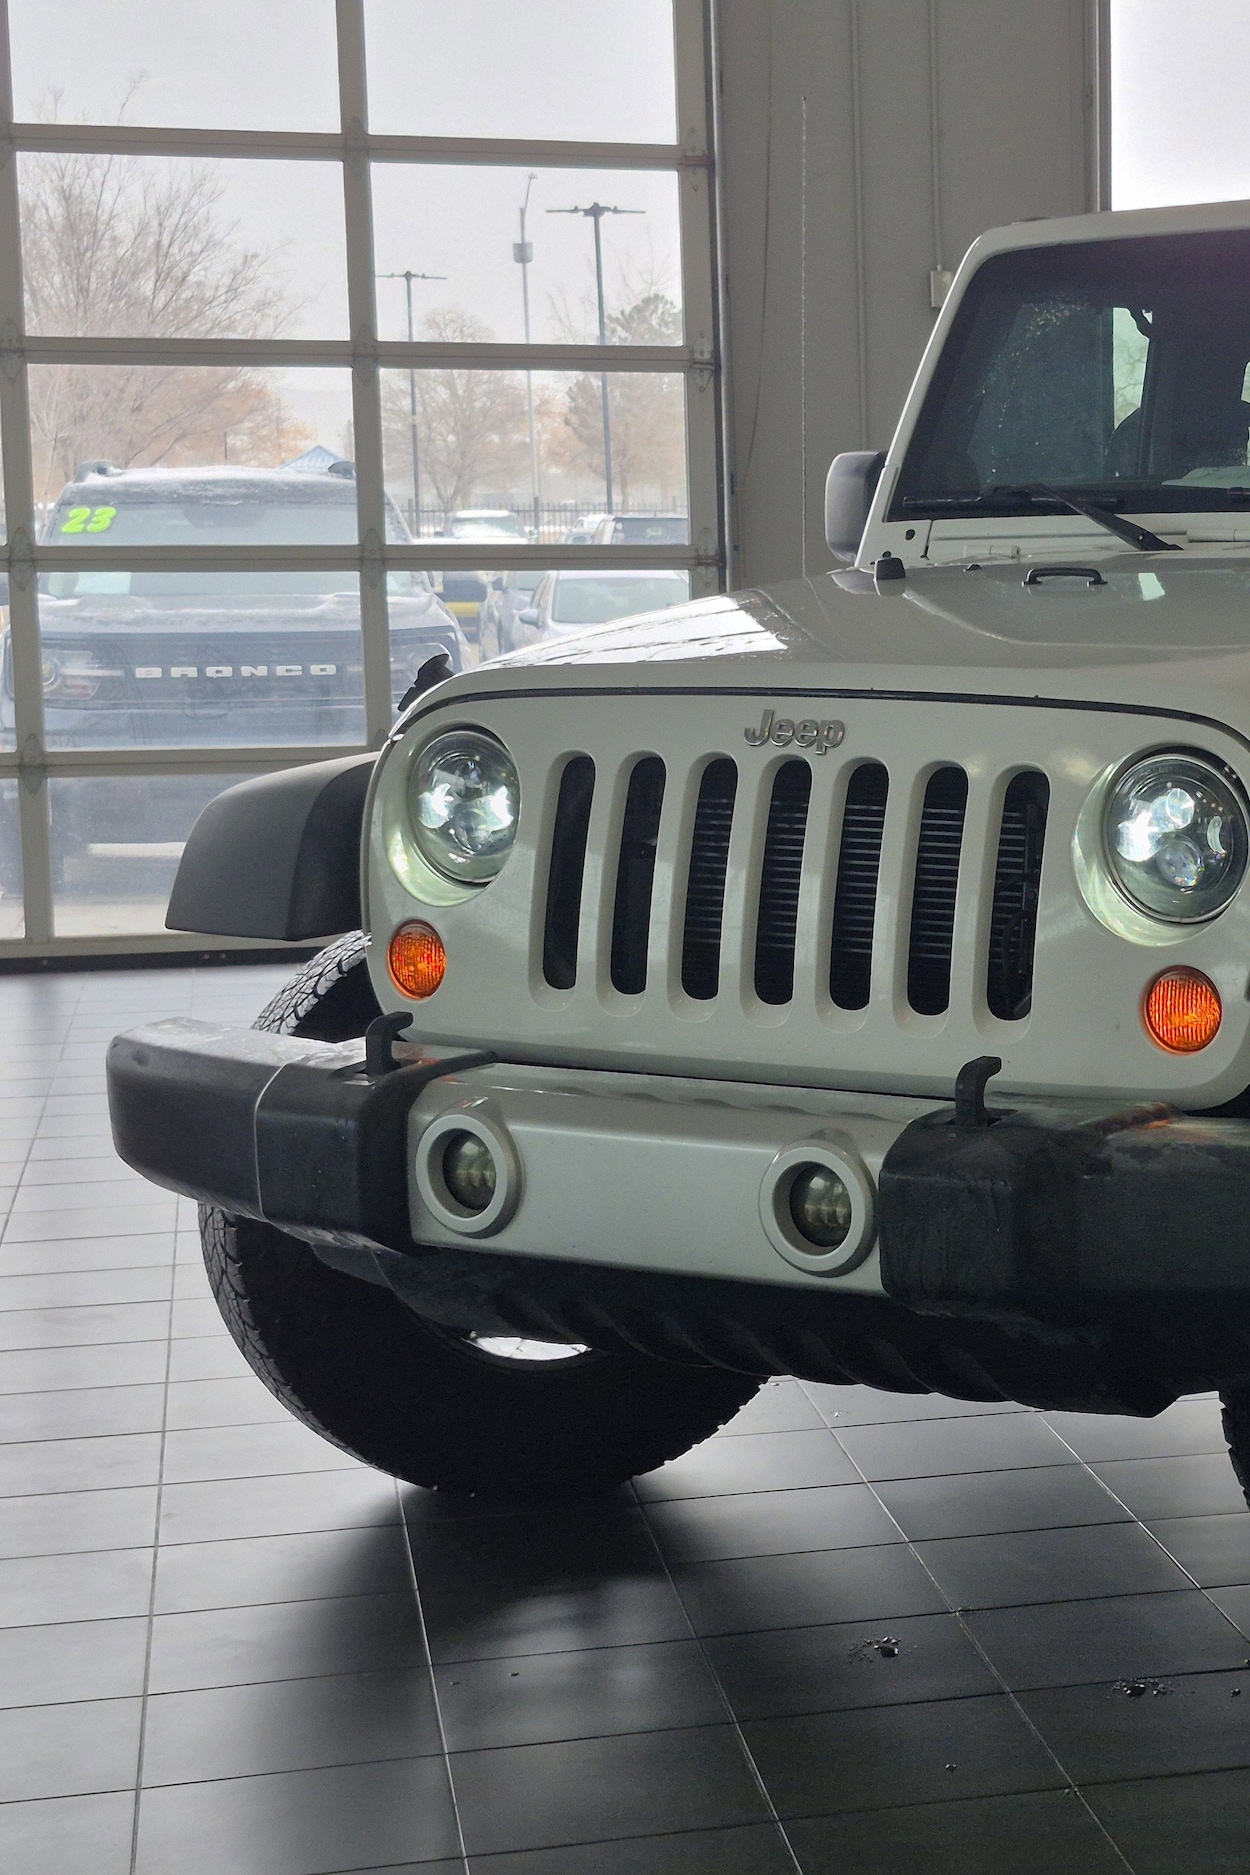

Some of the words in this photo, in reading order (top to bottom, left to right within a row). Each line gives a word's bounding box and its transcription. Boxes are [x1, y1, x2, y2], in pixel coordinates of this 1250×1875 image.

[61, 506, 118, 534] 23
[135, 664, 337, 679] BRONCO
[743, 708, 845, 756] Jeep
